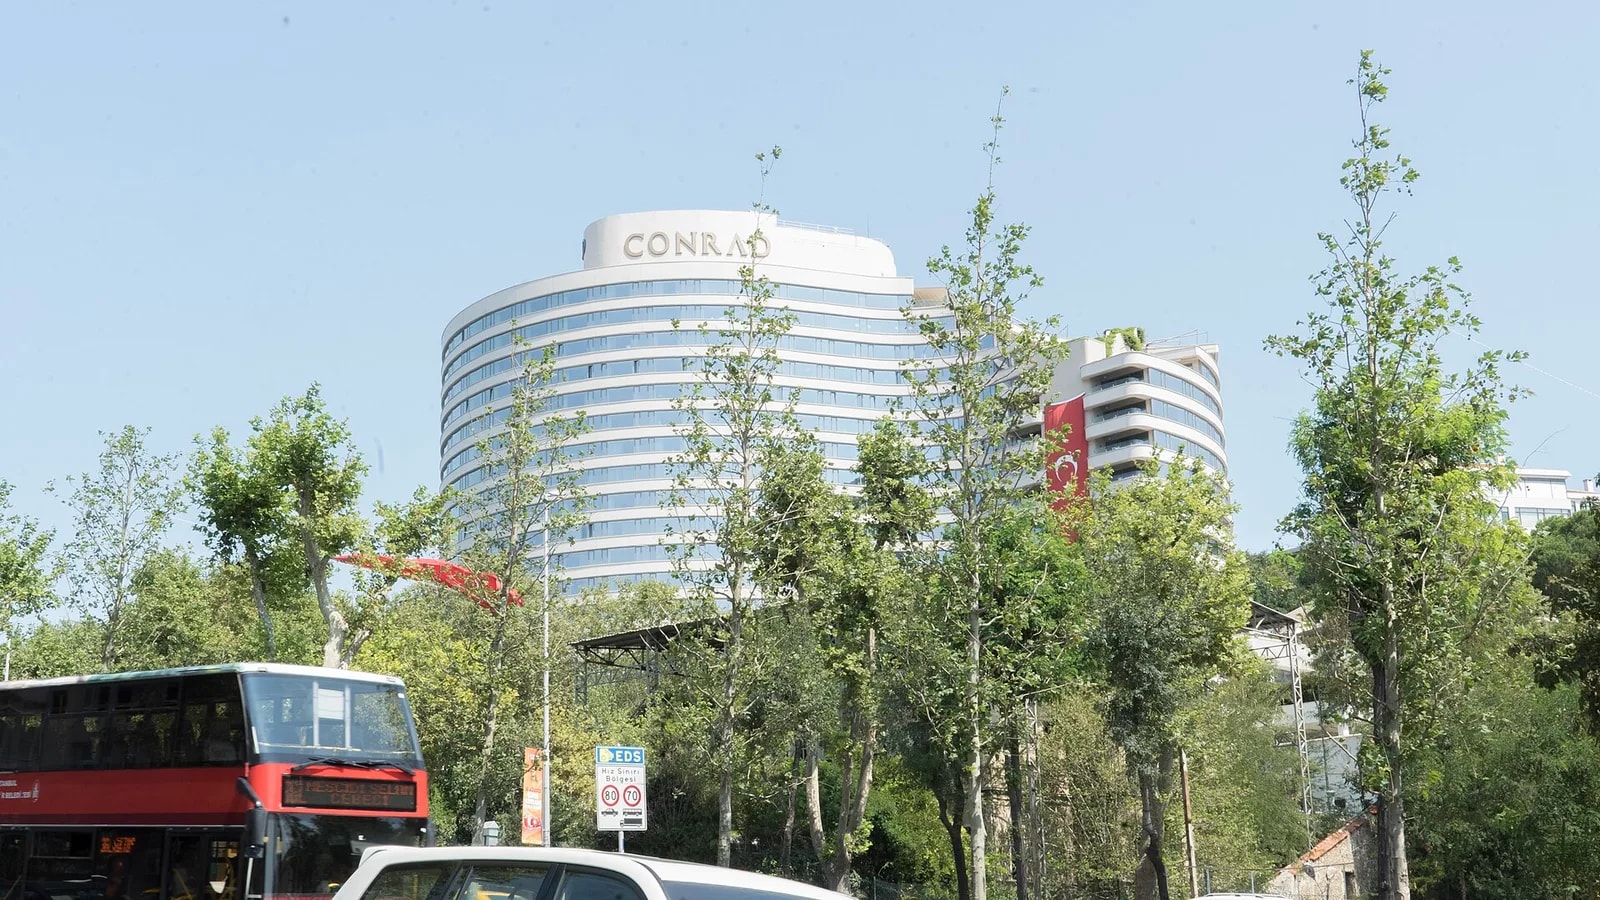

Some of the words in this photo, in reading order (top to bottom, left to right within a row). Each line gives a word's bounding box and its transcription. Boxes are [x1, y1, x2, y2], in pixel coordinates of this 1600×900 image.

[624, 231, 771, 258] CONRAD
[615, 750, 642, 762] EDS
[605, 775, 636, 784] Bölgesi
[604, 789, 617, 801] 80
[626, 789, 638, 801] 70
